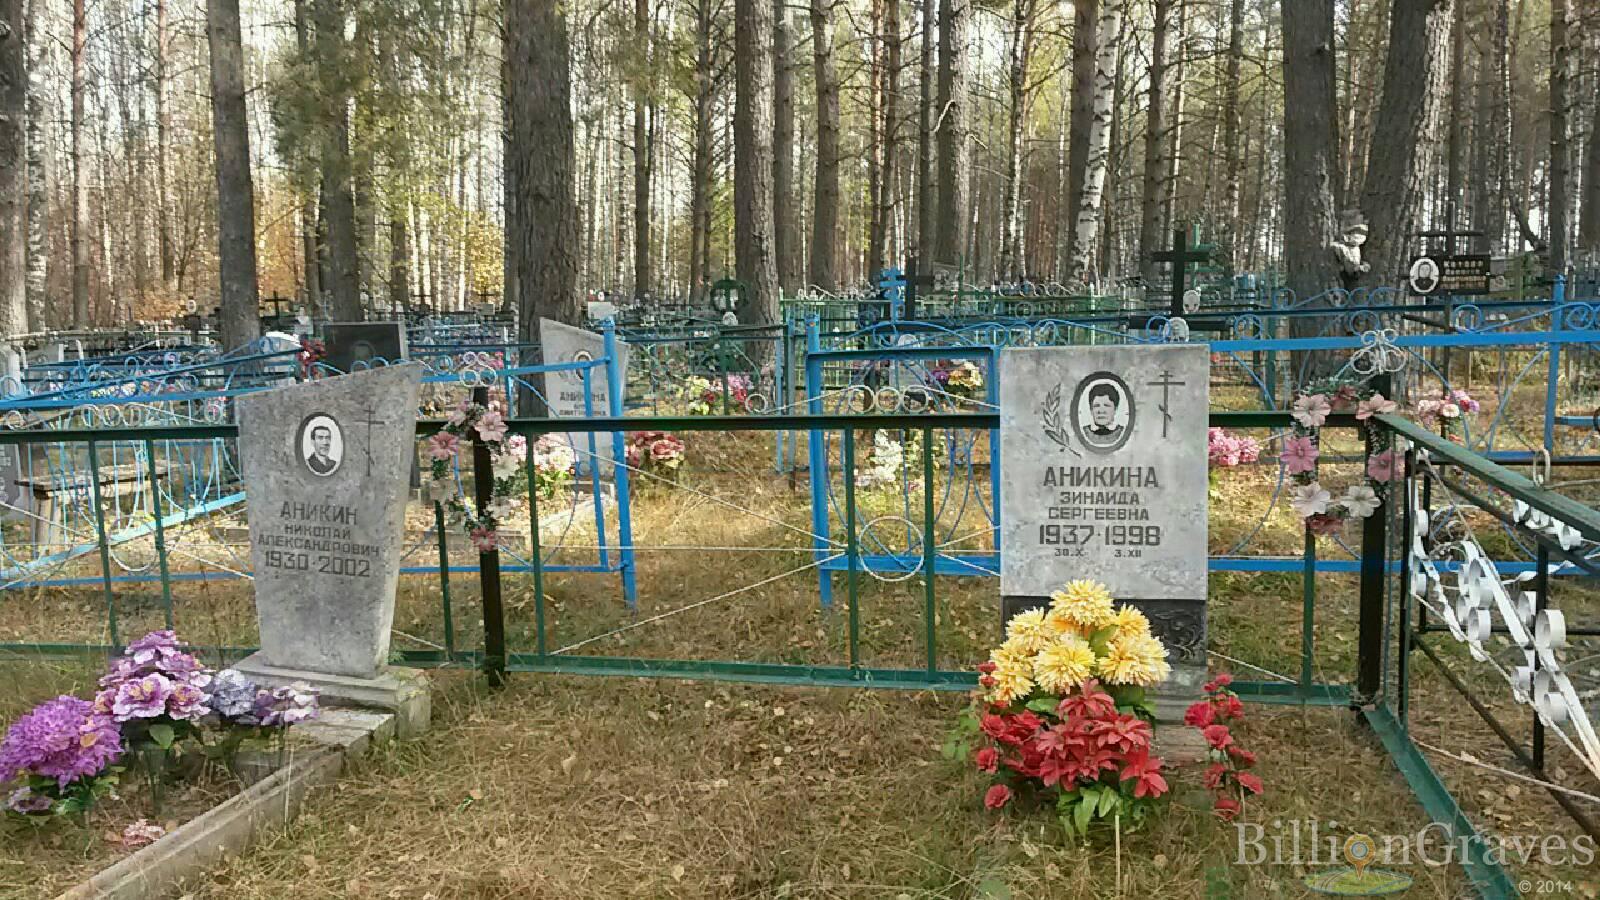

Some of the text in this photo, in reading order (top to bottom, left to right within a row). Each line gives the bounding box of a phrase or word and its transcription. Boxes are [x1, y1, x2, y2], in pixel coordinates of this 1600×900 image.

[1043, 466, 1159, 487] АНИКИНА
[1059, 491, 1140, 505] ЗИНАИДА
[280, 501, 358, 525] АНИКИН
[1048, 507, 1149, 521] СЕРГЕЕВНА
[284, 524, 350, 539] НИКОЛАЙ
[258, 534, 380, 557] АЛЕКСАНДРОВИЧ
